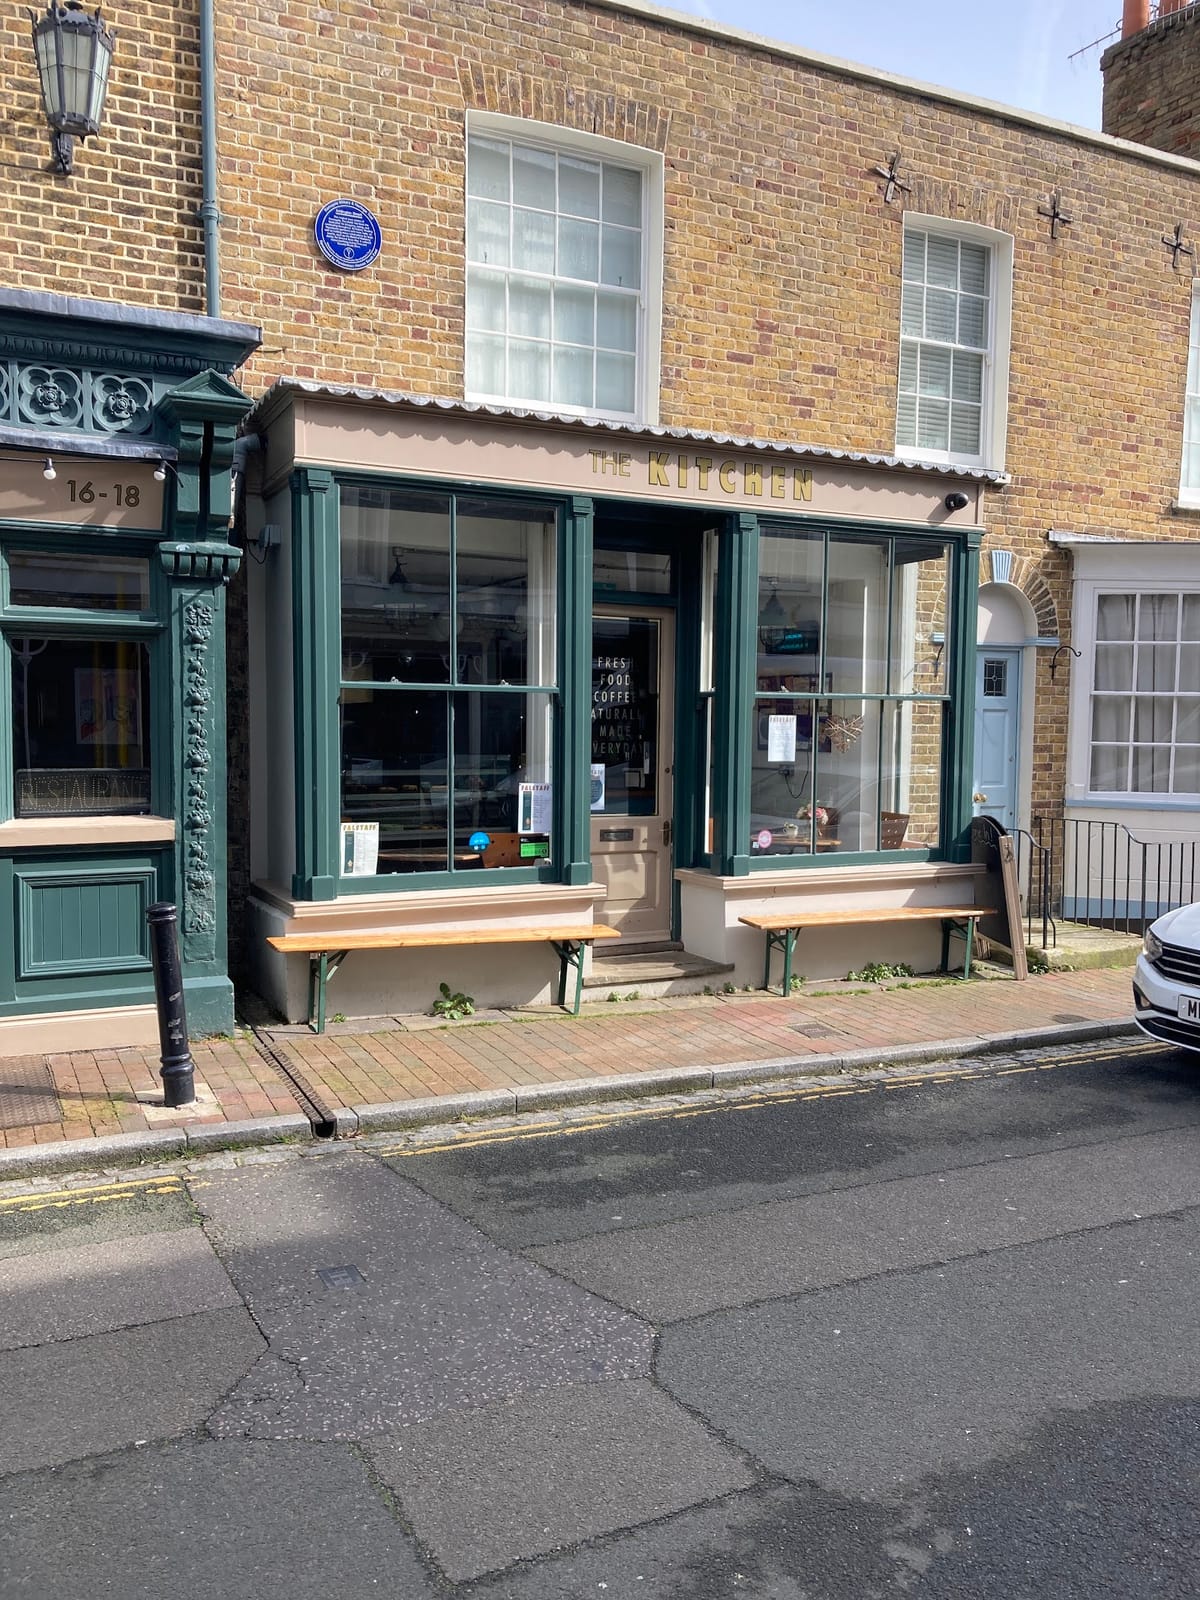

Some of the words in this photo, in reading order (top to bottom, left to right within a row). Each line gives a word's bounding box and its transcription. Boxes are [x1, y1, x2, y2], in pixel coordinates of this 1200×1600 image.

[589, 449, 631, 477] THE
[649, 451, 813, 501] KITCHEN
[67, 480, 140, 507] 16-18
[601, 674, 631, 686] FOOD
[21, 778, 147, 808] RESTAURANT
[1188, 1000, 1200, 1019] M
